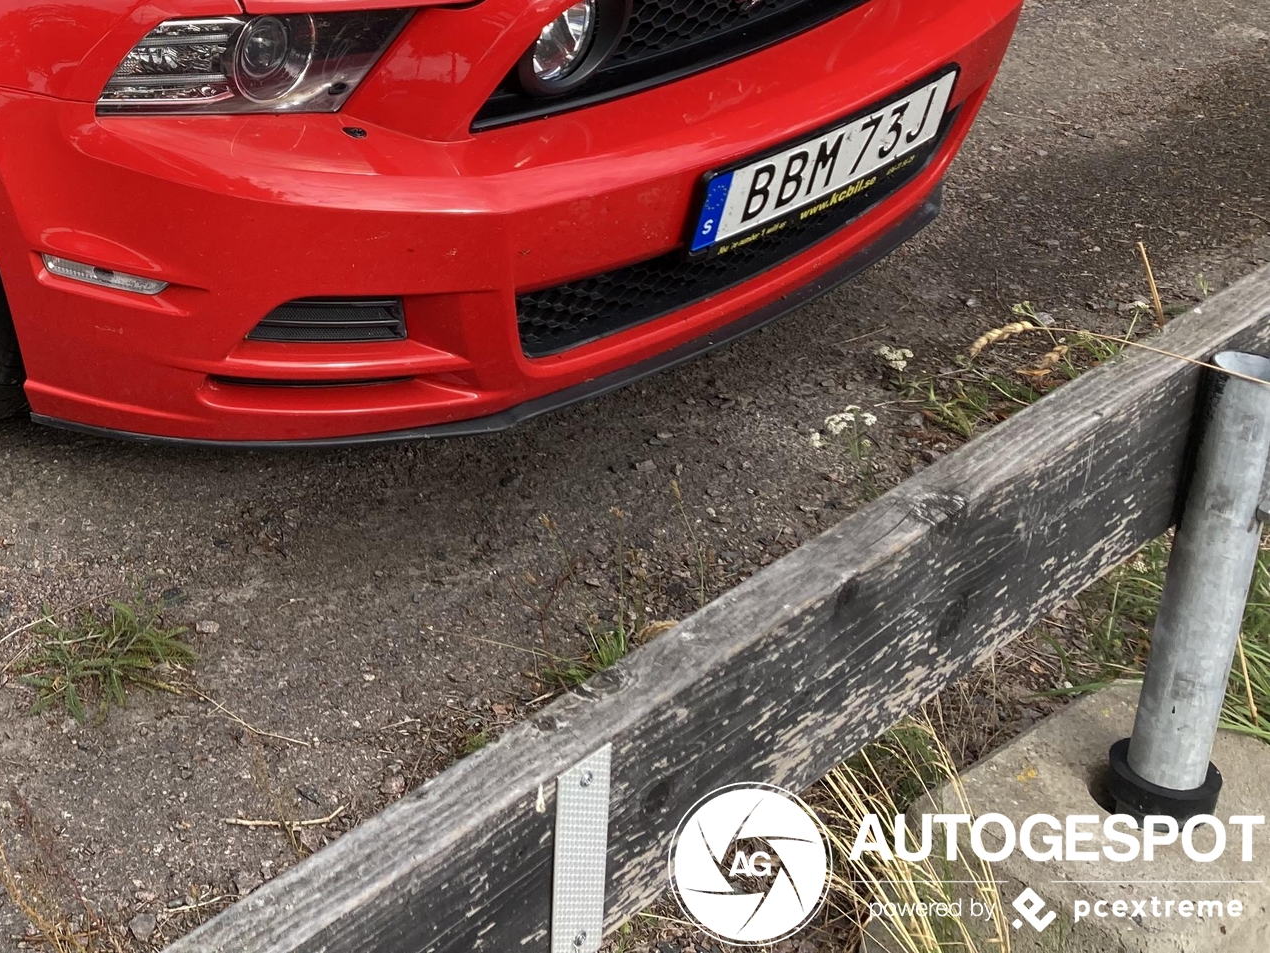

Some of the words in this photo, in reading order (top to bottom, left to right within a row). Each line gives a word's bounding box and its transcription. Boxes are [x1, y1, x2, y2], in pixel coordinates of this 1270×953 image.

[740, 131, 845, 223] BBM
[849, 85, 937, 176] 73J
[799, 176, 877, 220] www.kcbil.se
[702, 219, 714, 235] S
